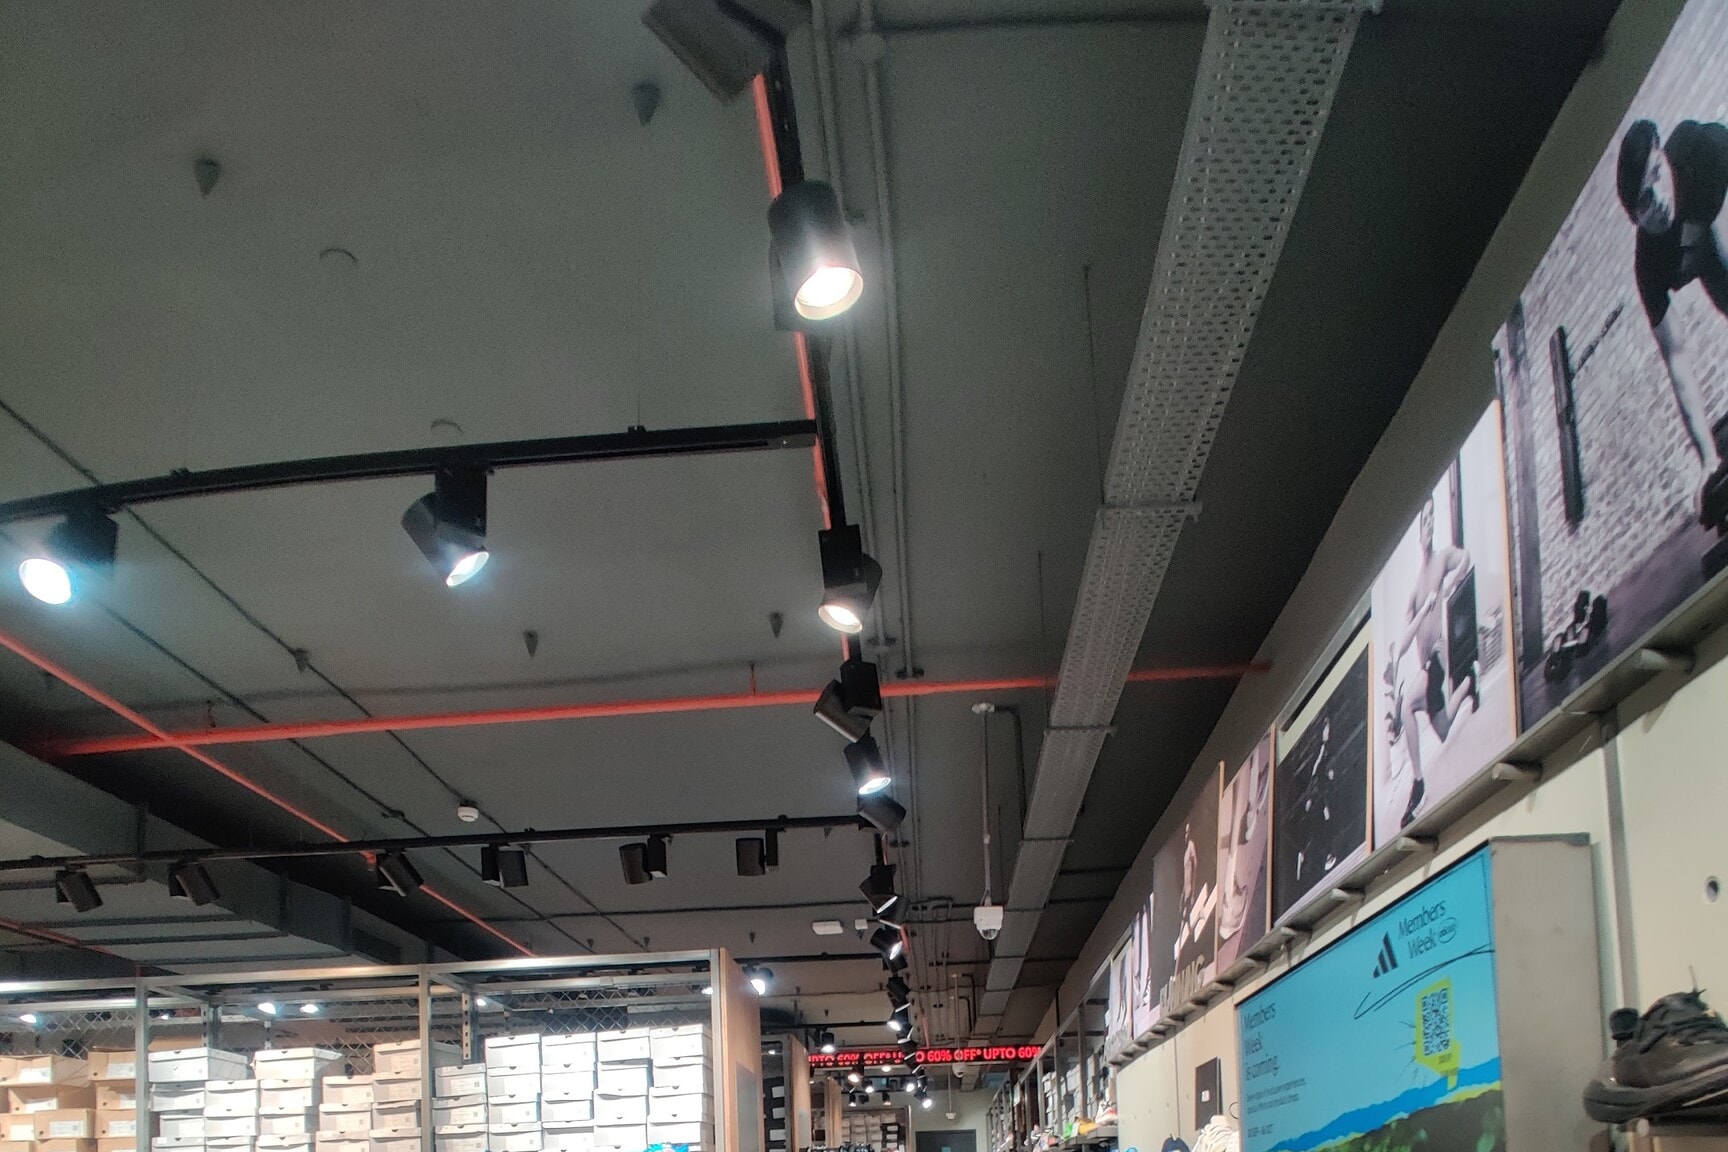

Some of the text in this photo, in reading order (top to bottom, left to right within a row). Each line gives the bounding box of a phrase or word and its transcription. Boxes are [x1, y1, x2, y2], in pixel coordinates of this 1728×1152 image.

[1399, 901, 1446, 937] Members
[1408, 928, 1437, 959] Week
[926, 1050, 952, 1062] 60%
[983, 1047, 1016, 1060] UPTO
